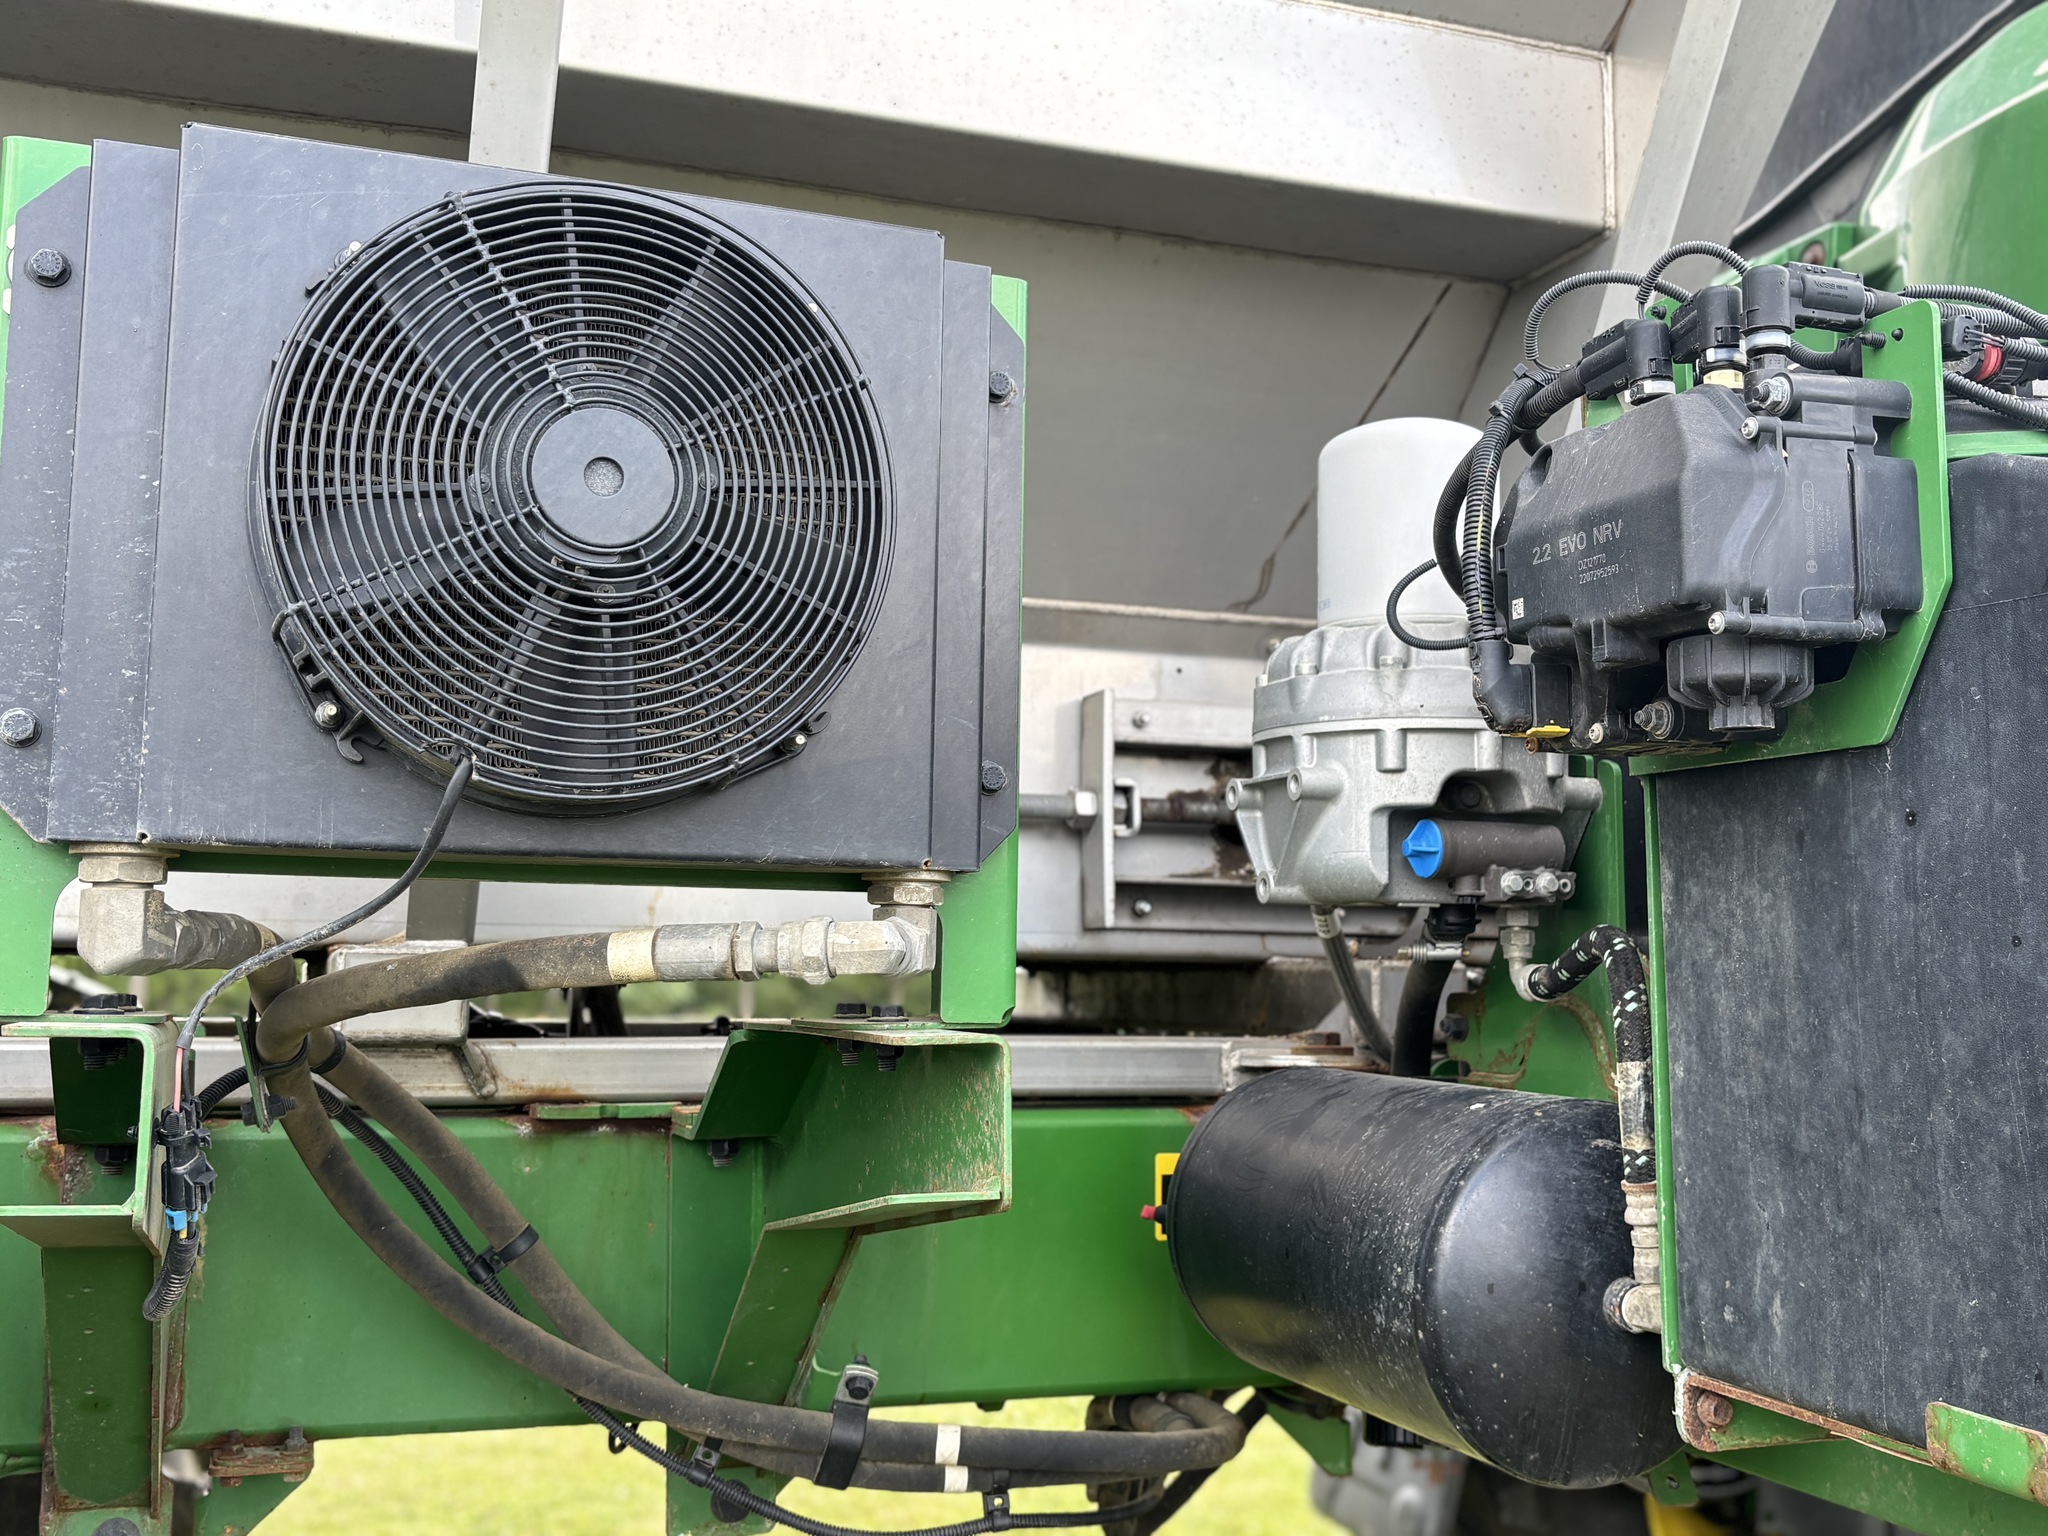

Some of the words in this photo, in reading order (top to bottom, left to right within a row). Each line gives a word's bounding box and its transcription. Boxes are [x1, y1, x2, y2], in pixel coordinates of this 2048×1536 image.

[1532, 544, 1551, 565] 2.2
[1559, 532, 1587, 557] EVO
[1593, 519, 1622, 545] NRV
[1805, 516, 1815, 556] BOSCH
